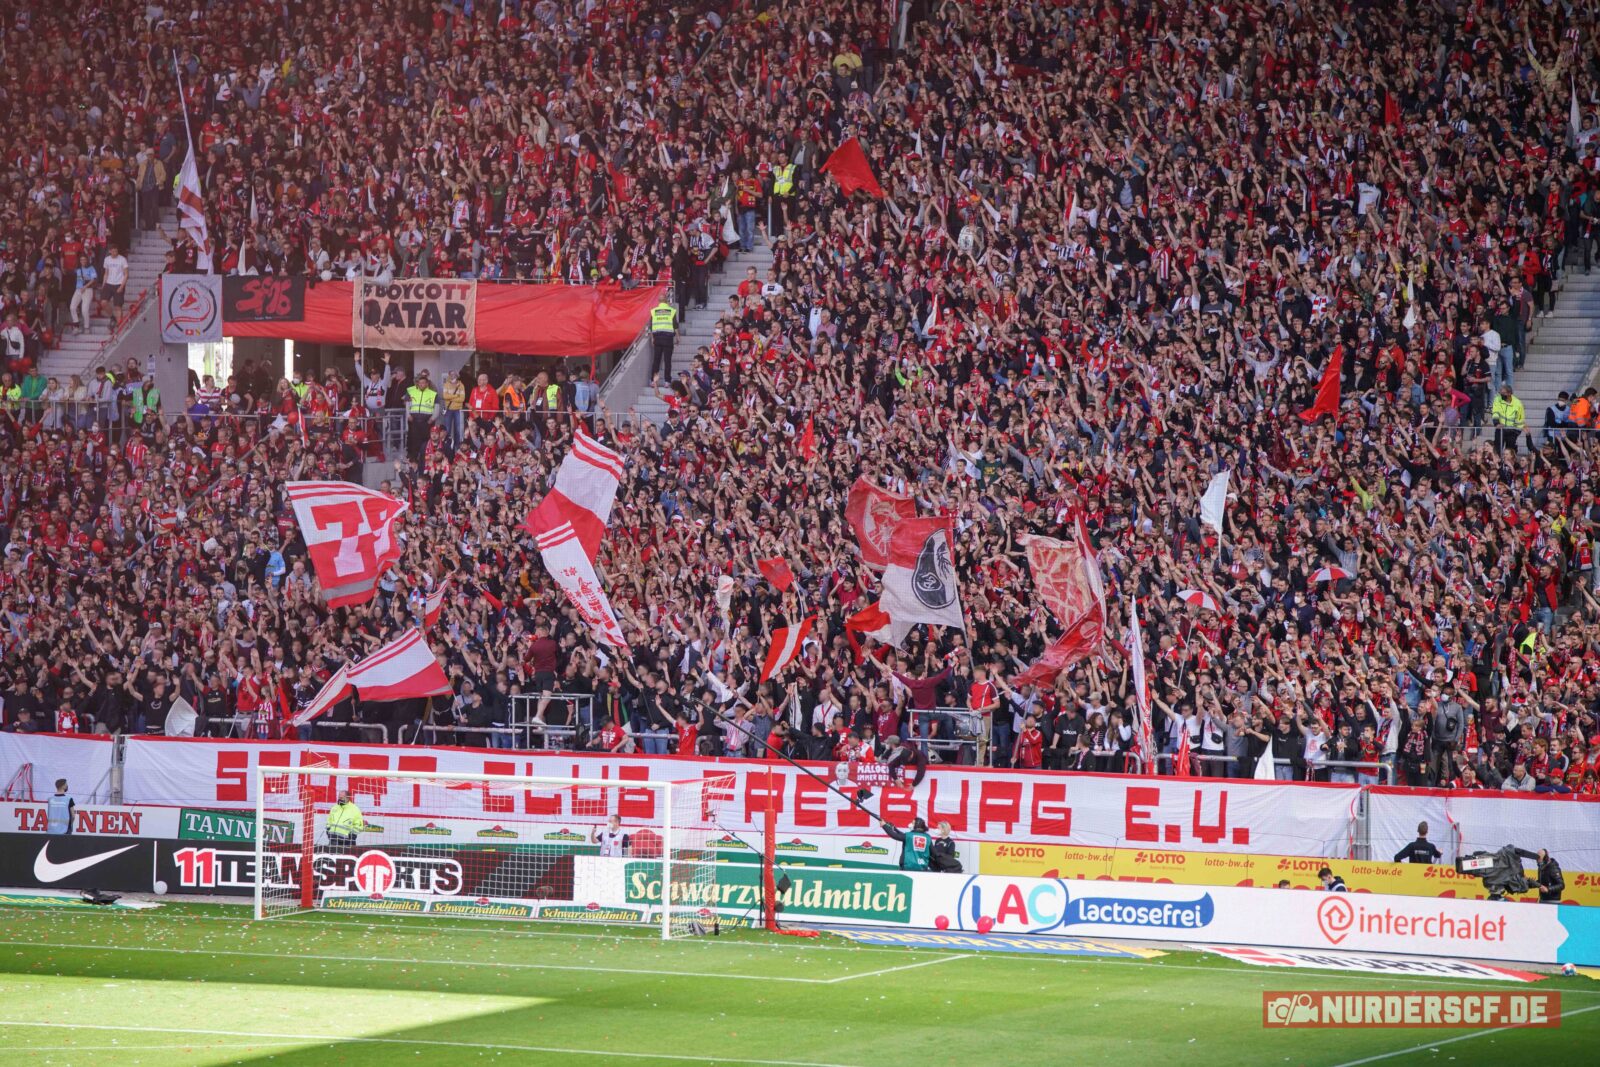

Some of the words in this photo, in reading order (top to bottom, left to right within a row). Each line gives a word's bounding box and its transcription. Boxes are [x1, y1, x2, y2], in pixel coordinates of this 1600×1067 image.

[359, 299, 467, 329] QATAR
[422, 331, 469, 346] 2022
[702, 769, 1072, 837] FREIBURG
[14, 807, 143, 835] TANEN
[1010, 847, 1045, 858] LOTTO
[1065, 851, 1113, 861] lotto-bw.de
[1149, 853, 1186, 864] LOTTO
[1204, 858, 1255, 868] lotto-bw.de
[1351, 866, 1403, 876] lotto-bw.de
[327, 899, 421, 911] Schwarzwaldmilch
[433, 903, 528, 917] Schwarzwaldmilch
[971, 883, 1057, 925] LAC
[542, 908, 638, 921] Schwarzwaldmilch
[1079, 899, 1203, 928] lactosefrei
[1359, 906, 1507, 942] interchalet
